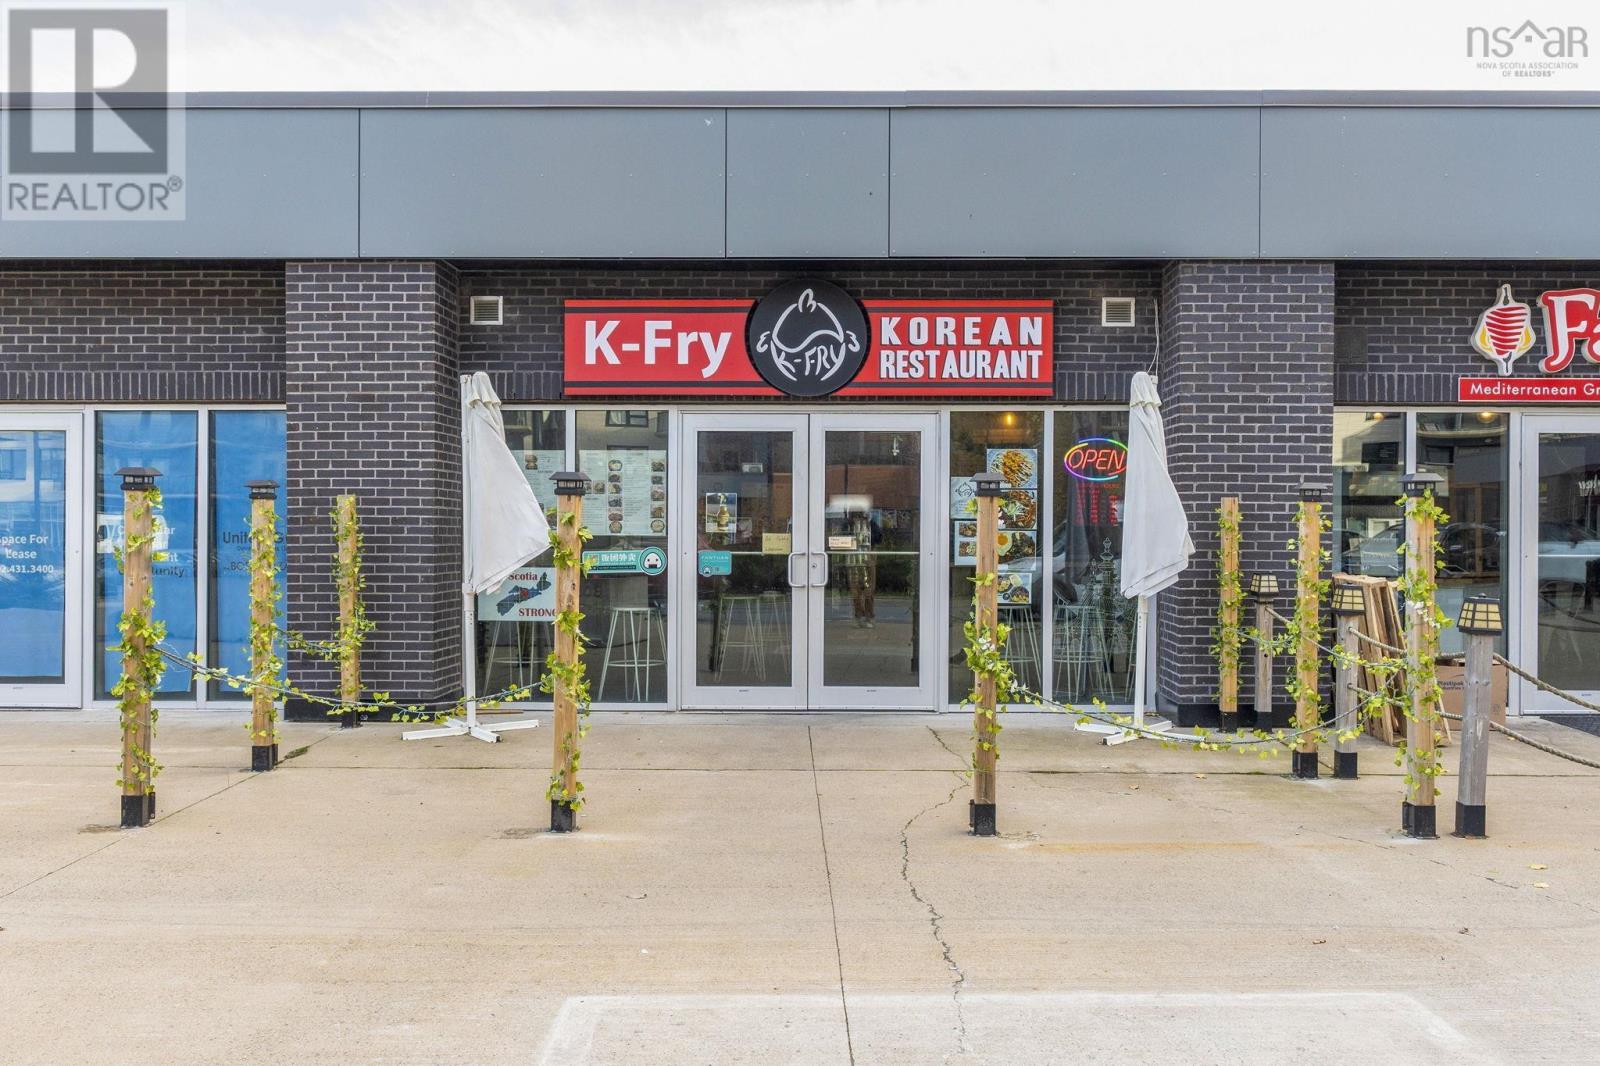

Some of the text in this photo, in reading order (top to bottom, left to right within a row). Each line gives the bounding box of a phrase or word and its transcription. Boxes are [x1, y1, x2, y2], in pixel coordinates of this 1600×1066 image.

[880, 316, 1043, 346] KOREAN
[585, 319, 731, 378] K-Fry
[879, 349, 1040, 379] RESTAURANT
[1470, 382, 1577, 396] Mediterranean
[1068, 449, 1126, 470] OPEN
[0, 534, 49, 546] pace For
[6, 549, 38, 559] Lease
